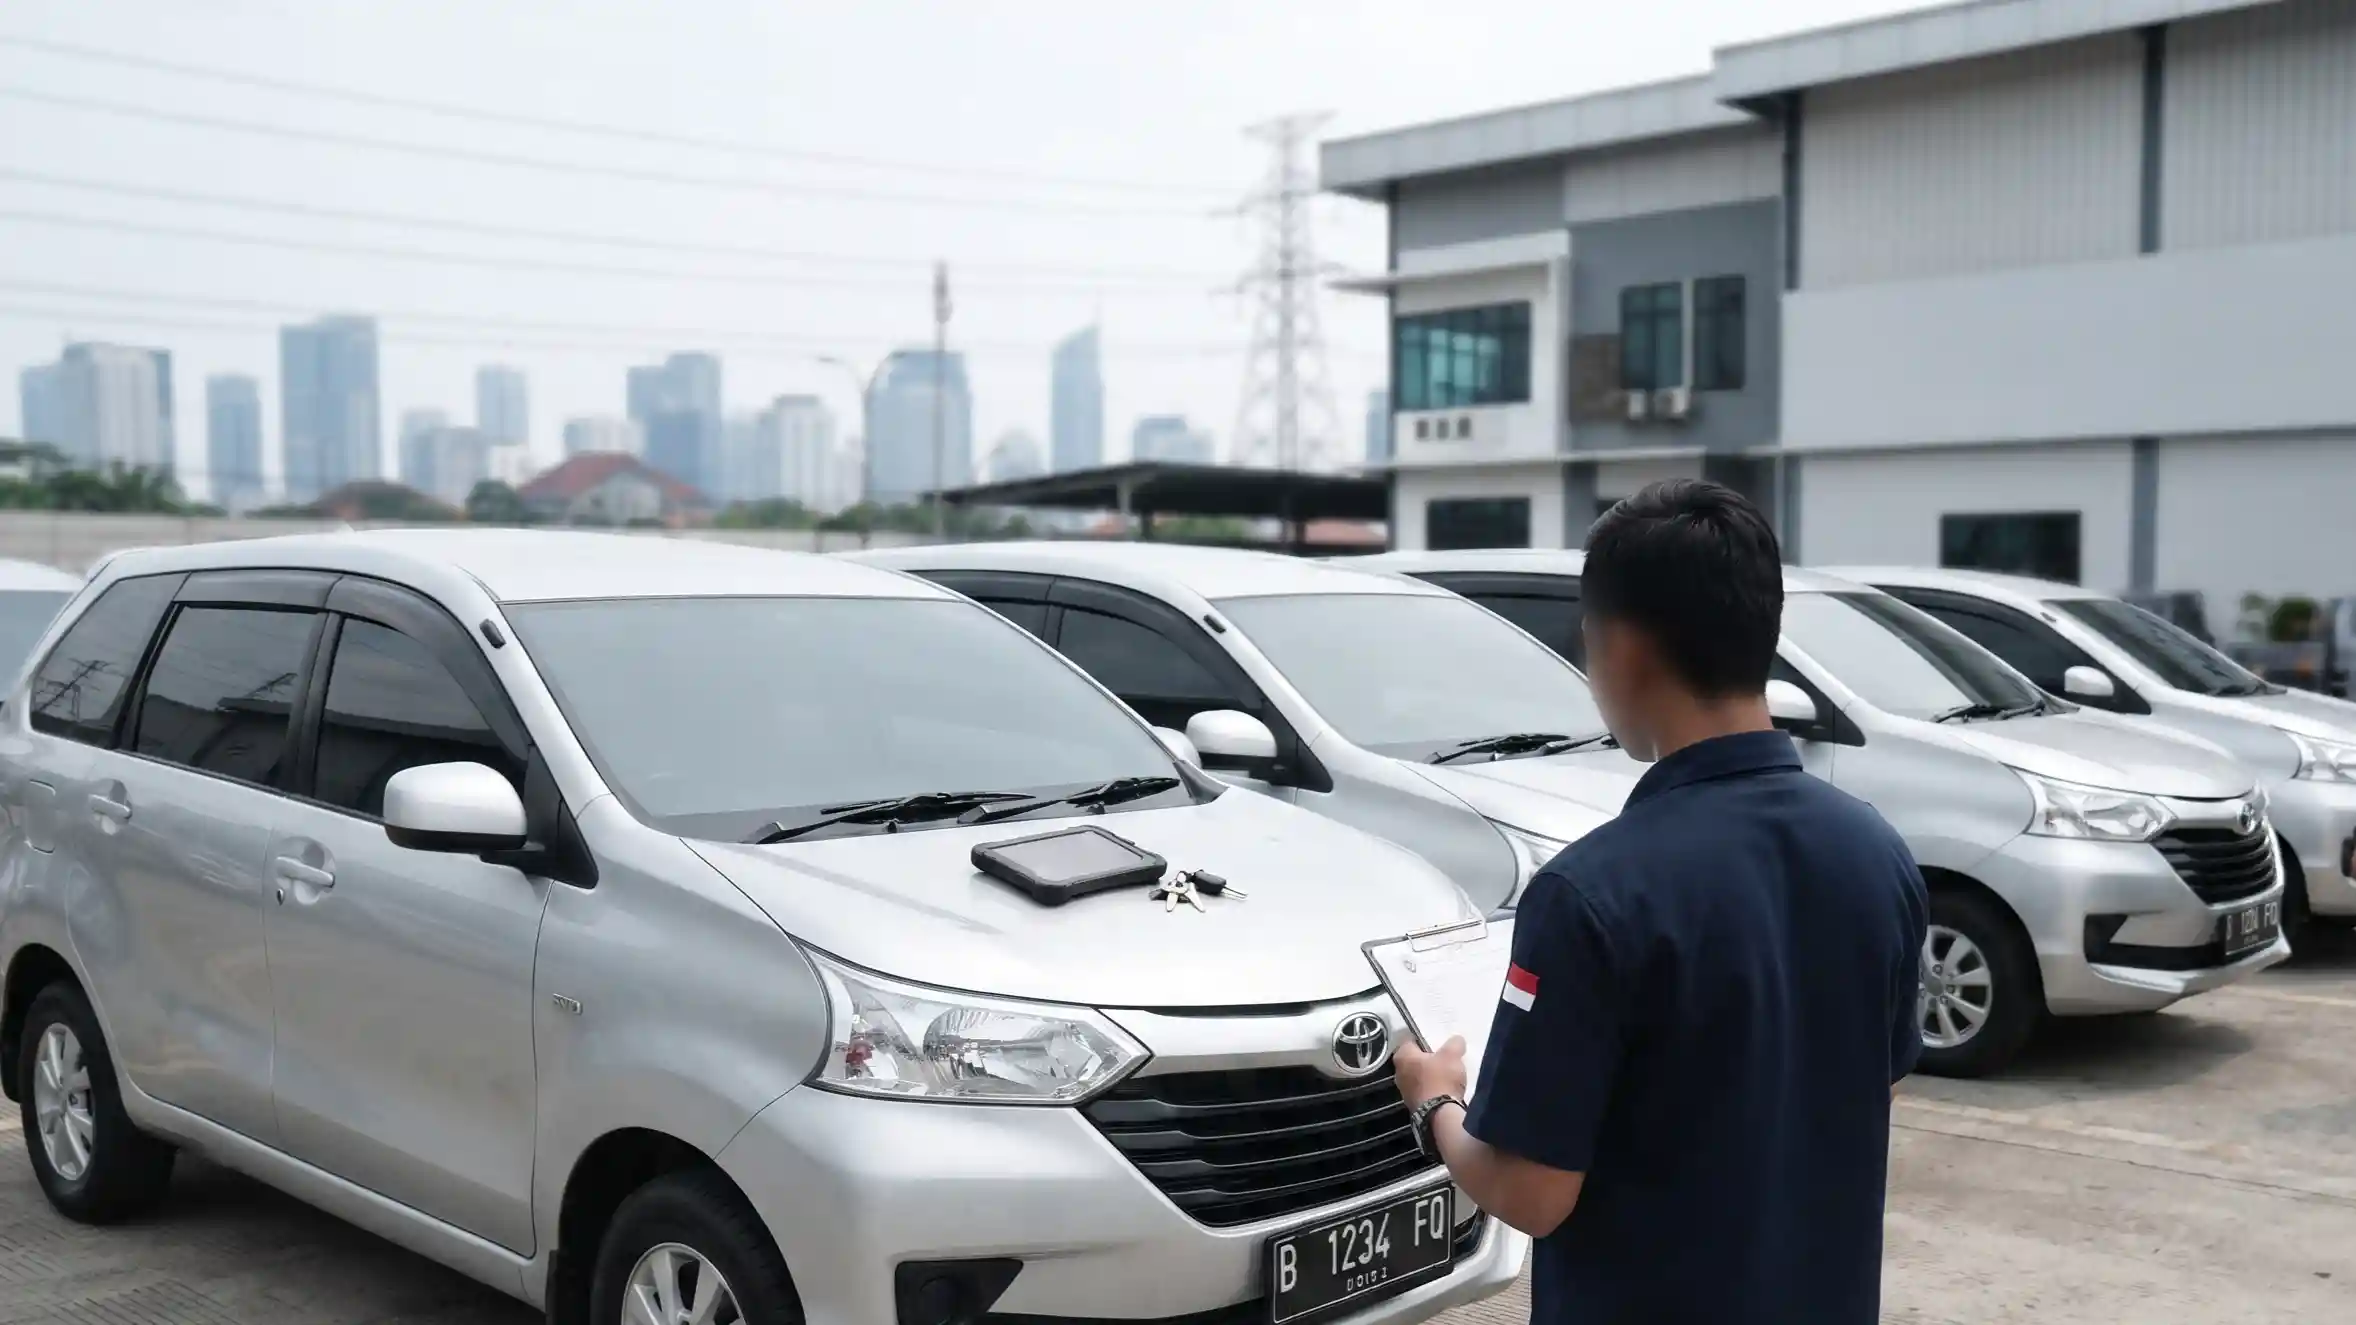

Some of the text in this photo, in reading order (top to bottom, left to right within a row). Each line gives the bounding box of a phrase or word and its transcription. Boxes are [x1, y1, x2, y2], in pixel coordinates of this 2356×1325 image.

[1280, 1195, 1444, 1293] B 1234 FQ
